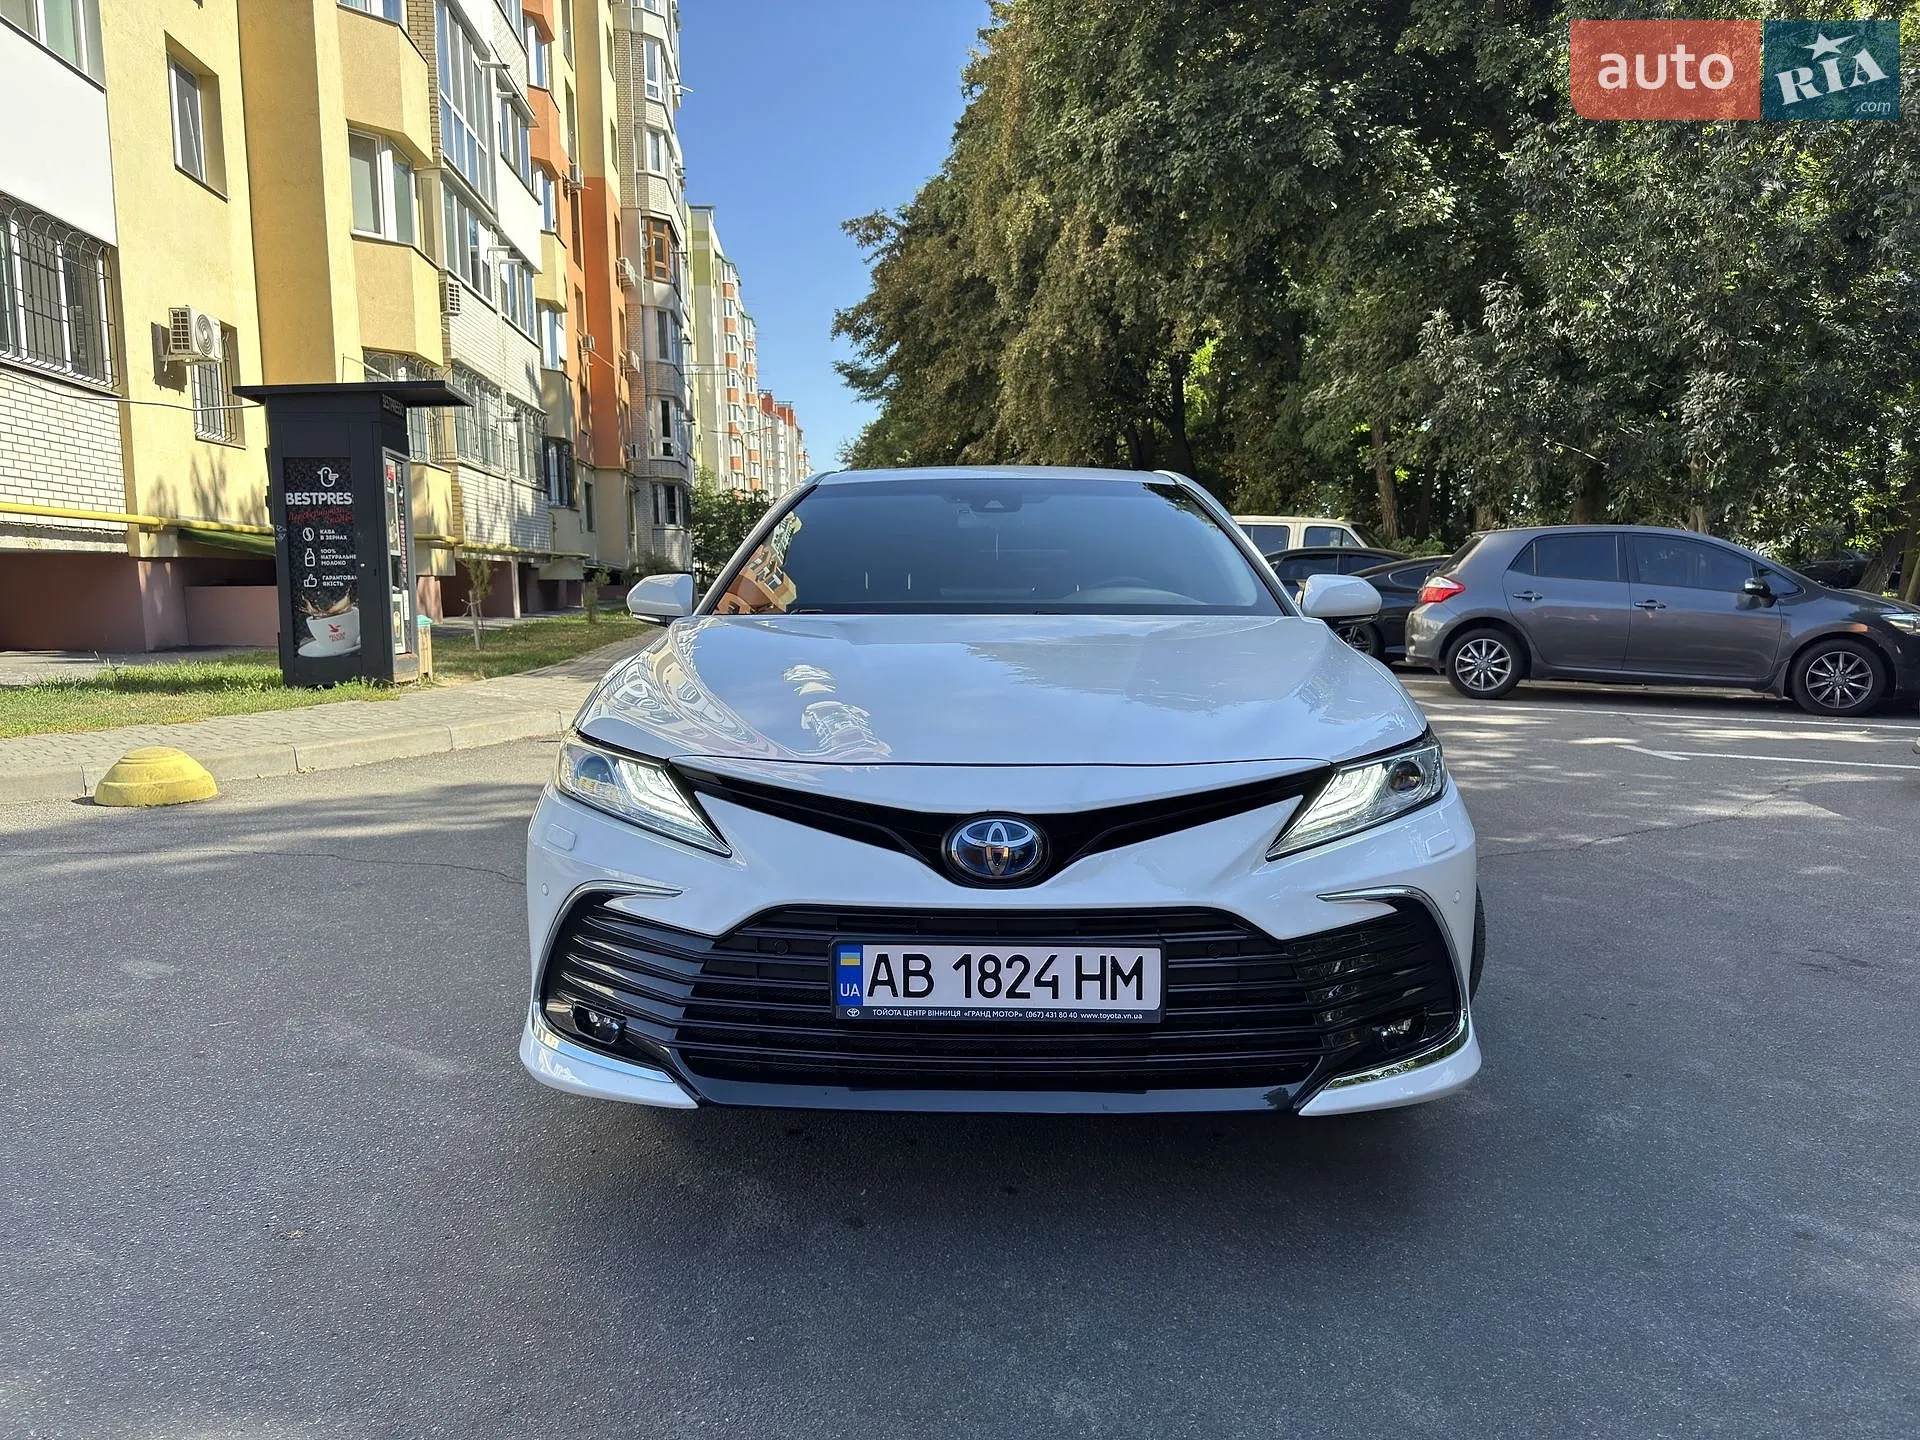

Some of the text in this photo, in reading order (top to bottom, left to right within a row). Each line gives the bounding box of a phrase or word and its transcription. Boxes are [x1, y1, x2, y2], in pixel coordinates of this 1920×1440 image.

[285, 492, 354, 505] BESTPRES
[867, 953, 1143, 1000] AB 1824 HM
[840, 983, 860, 997] UA
[873, 1008, 901, 1016] ТОЙОТА
[903, 1009, 926, 1017] ЦЕНТР
[928, 1010, 960, 1018] ВІННИЦЯ
[963, 1010, 991, 1018] «ГРАНД
[992, 1010, 1023, 1018] МОТОР»
[1025, 1010, 1044, 1019] (067)
[1058, 1011, 1068, 1019] 80
[1068, 1011, 1078, 1019] 40
[1080, 1012, 1143, 1020] www.toyota.vn.ua
